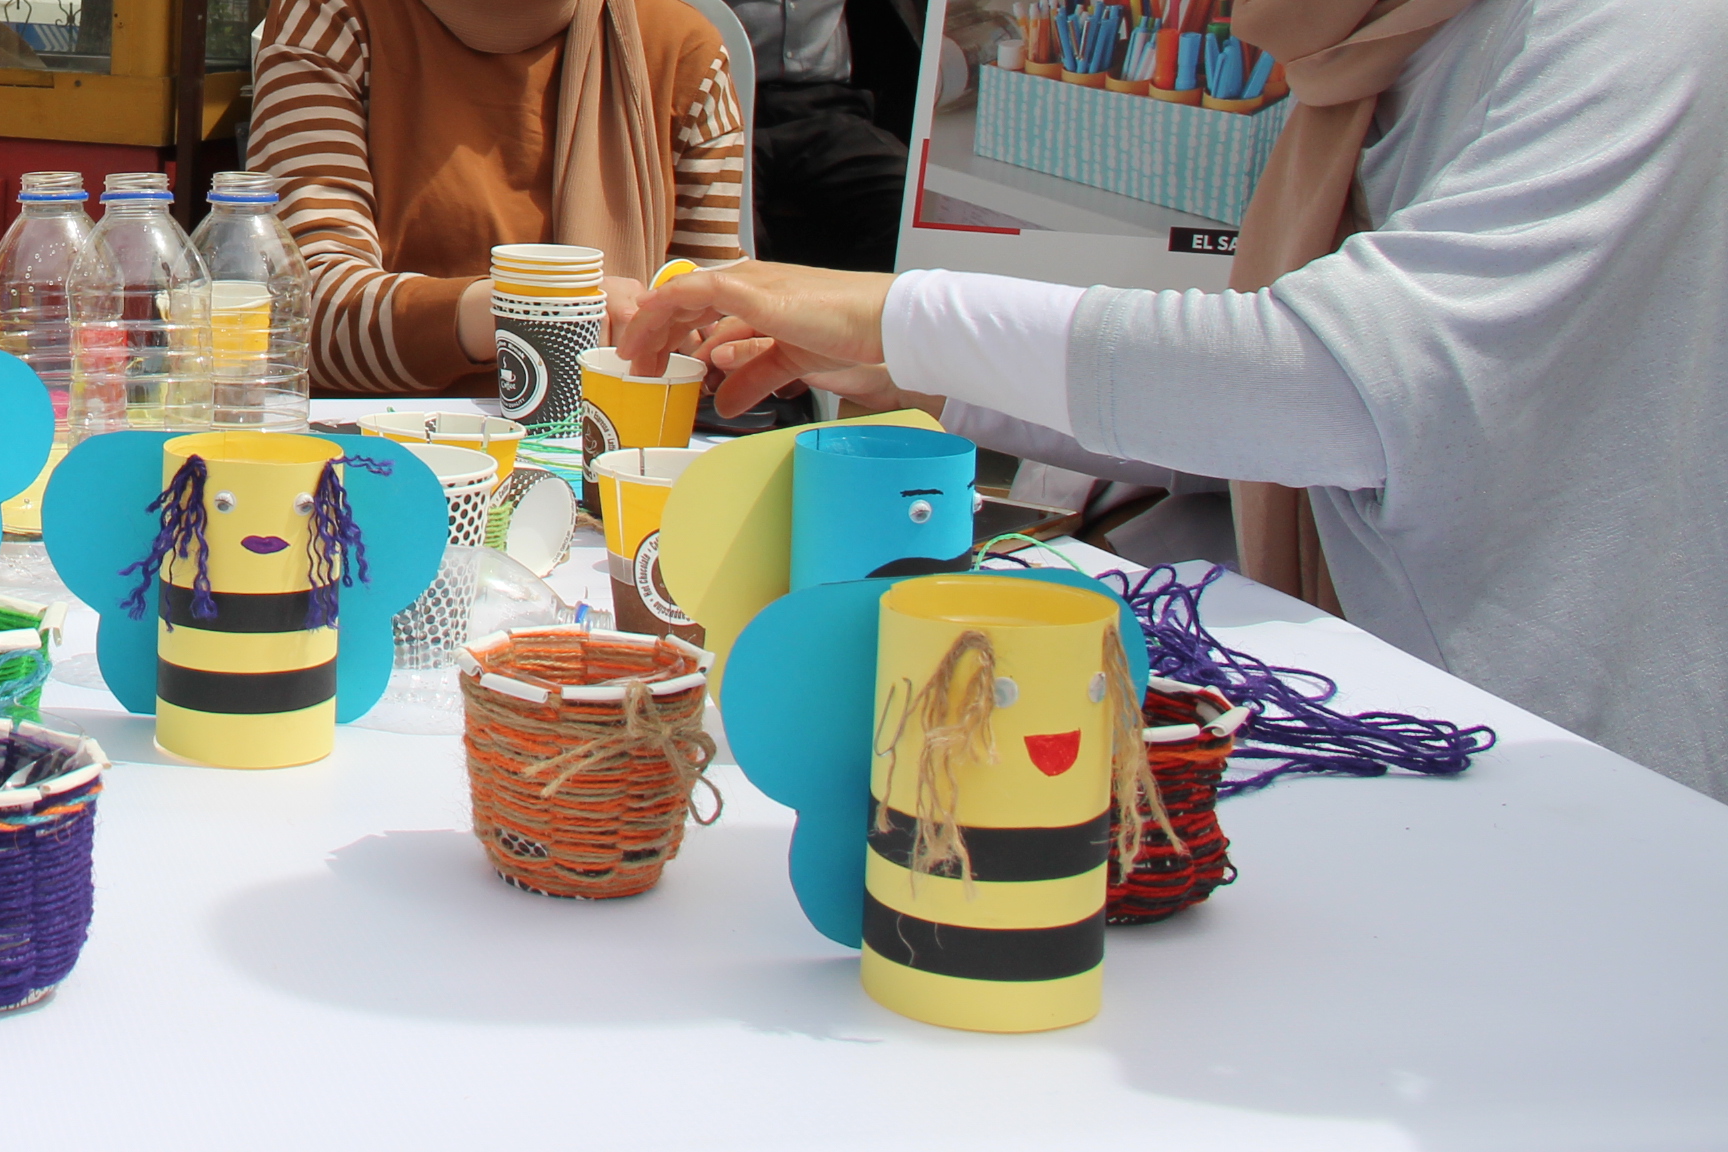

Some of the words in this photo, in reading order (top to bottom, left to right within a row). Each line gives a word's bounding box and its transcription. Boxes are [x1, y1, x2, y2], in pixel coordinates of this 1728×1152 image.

[1192, 234, 1214, 250] EL
[1217, 235, 1239, 251] SA
[638, 553, 651, 584] Chocolate
[641, 585, 653, 598] Hot
